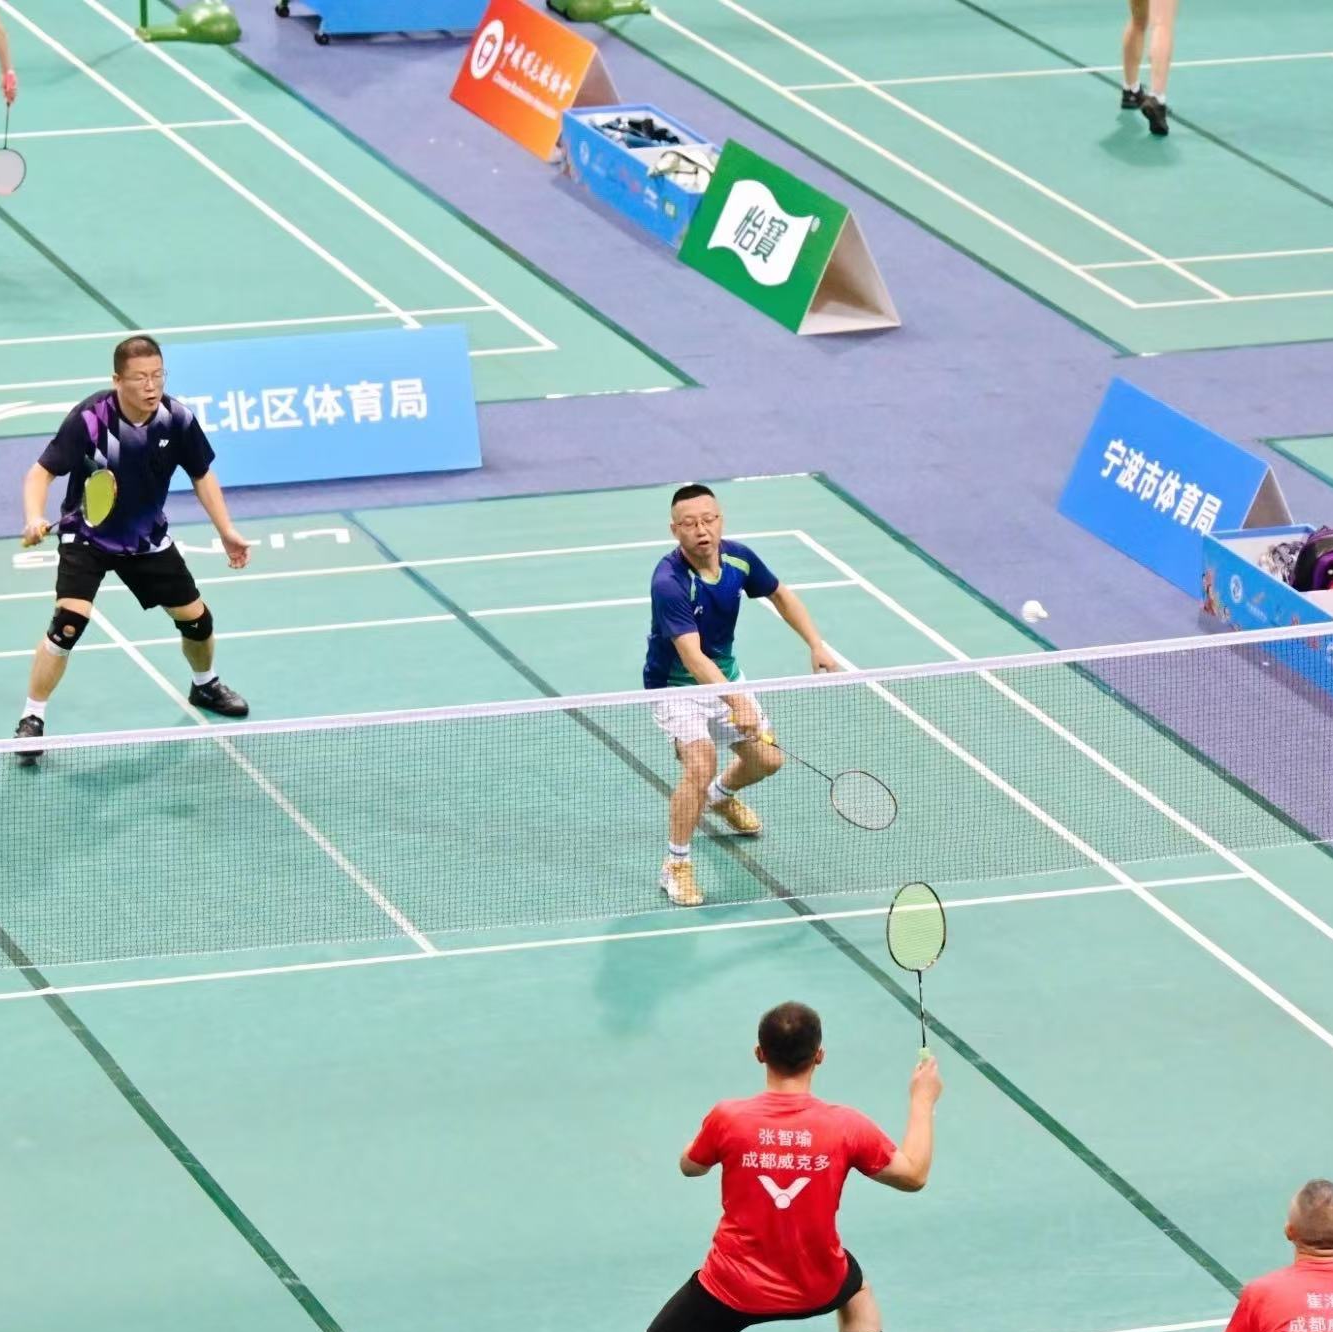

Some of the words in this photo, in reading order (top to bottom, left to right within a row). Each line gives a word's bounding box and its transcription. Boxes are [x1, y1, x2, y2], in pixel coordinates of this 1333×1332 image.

[1100, 439, 1223, 536] 宁波市体育局
[741, 1151, 831, 1171] 成都威克多
